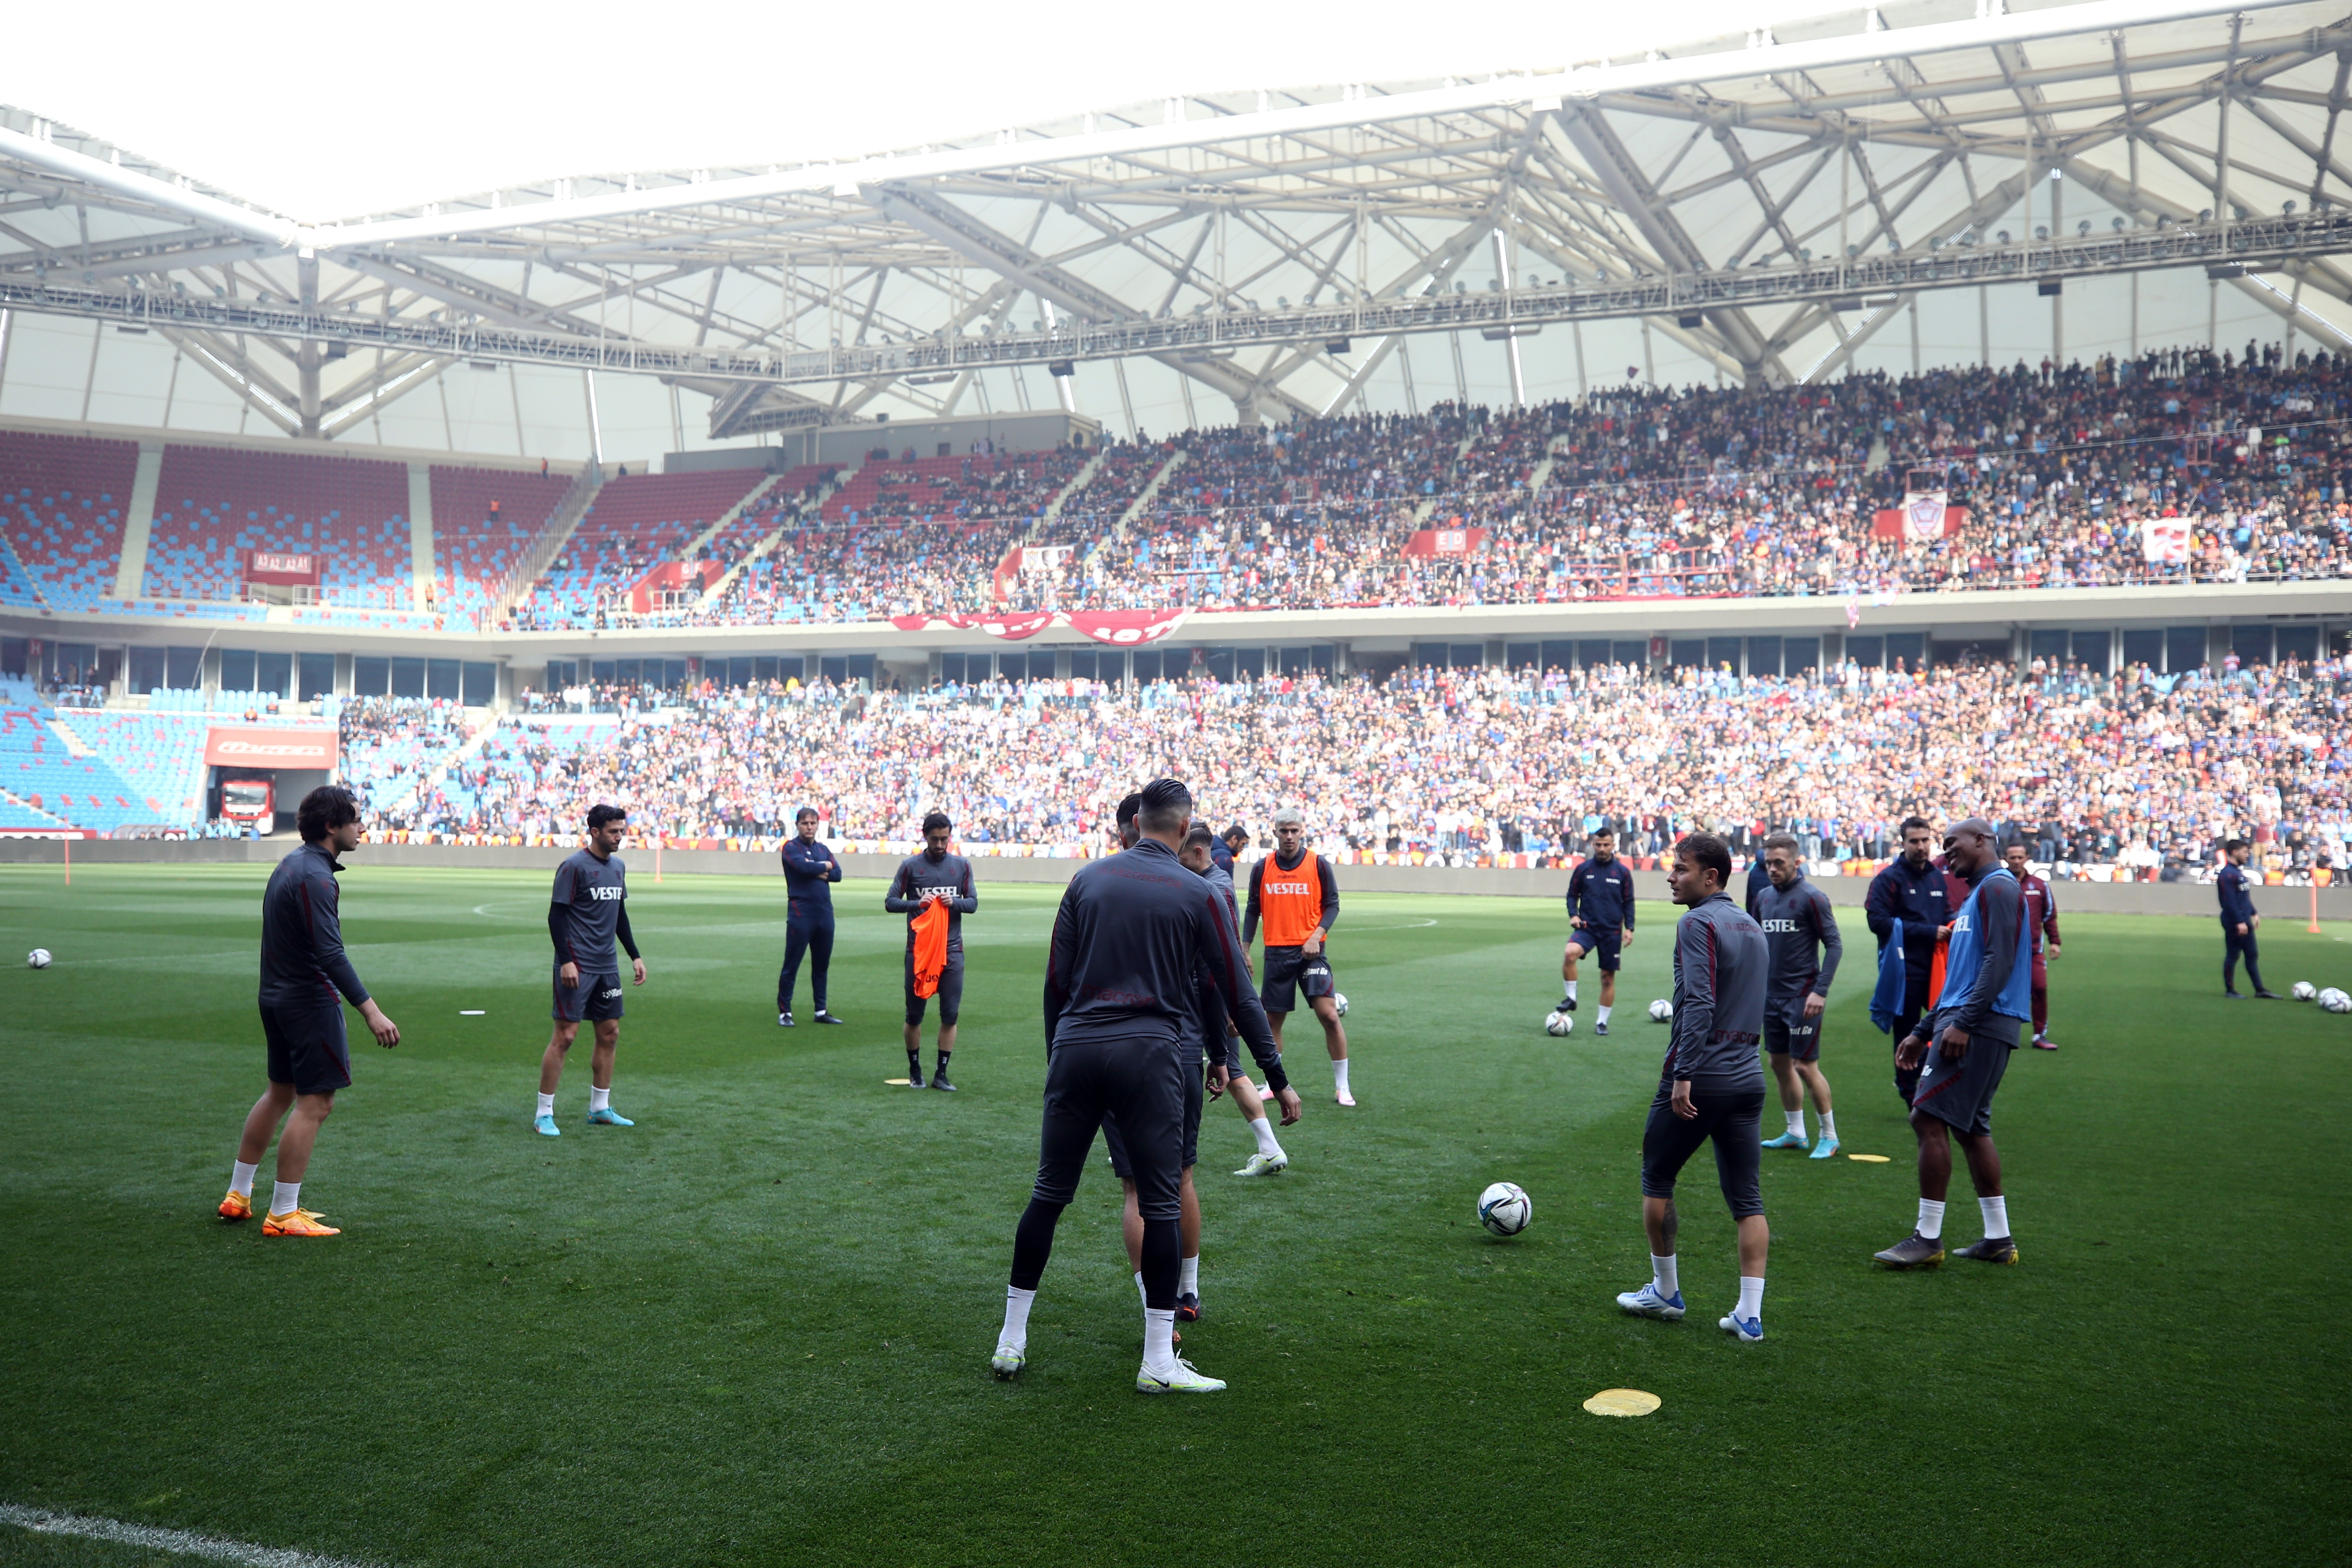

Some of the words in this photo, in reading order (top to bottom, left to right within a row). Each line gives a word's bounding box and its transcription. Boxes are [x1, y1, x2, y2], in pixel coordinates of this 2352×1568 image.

[1439, 533, 1447, 545] E
[1454, 532, 1463, 544] D
[31, 640, 40, 655] H
[1654, 642, 1661, 655] J
[1194, 651, 1201, 663] K
[689, 660, 696, 672] L
[590, 887, 622, 900] VESTE
[1265, 882, 1310, 894] VESTEL
[1762, 919, 1799, 932] ESTEL
[1320, 967, 1328, 975] Go
[1081, 985, 1156, 1009] macron
[1802, 1026, 1813, 1035] Go
